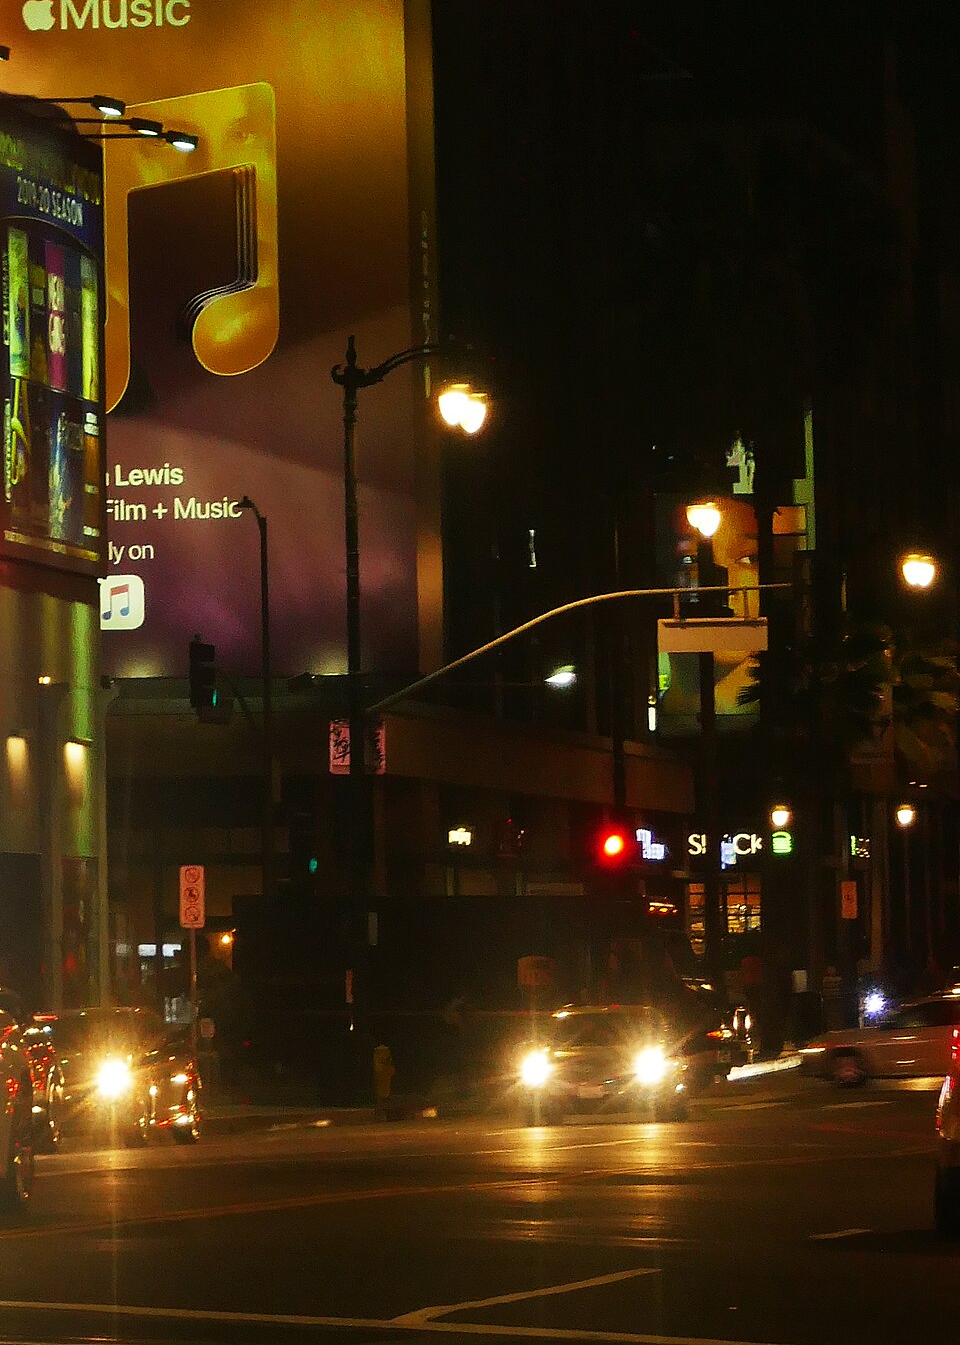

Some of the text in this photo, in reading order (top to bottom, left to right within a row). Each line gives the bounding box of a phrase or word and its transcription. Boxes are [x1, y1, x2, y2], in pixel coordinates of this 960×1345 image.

[114, 462, 184, 487] Lewis
[173, 496, 243, 520] Music
[128, 543, 154, 560] on
